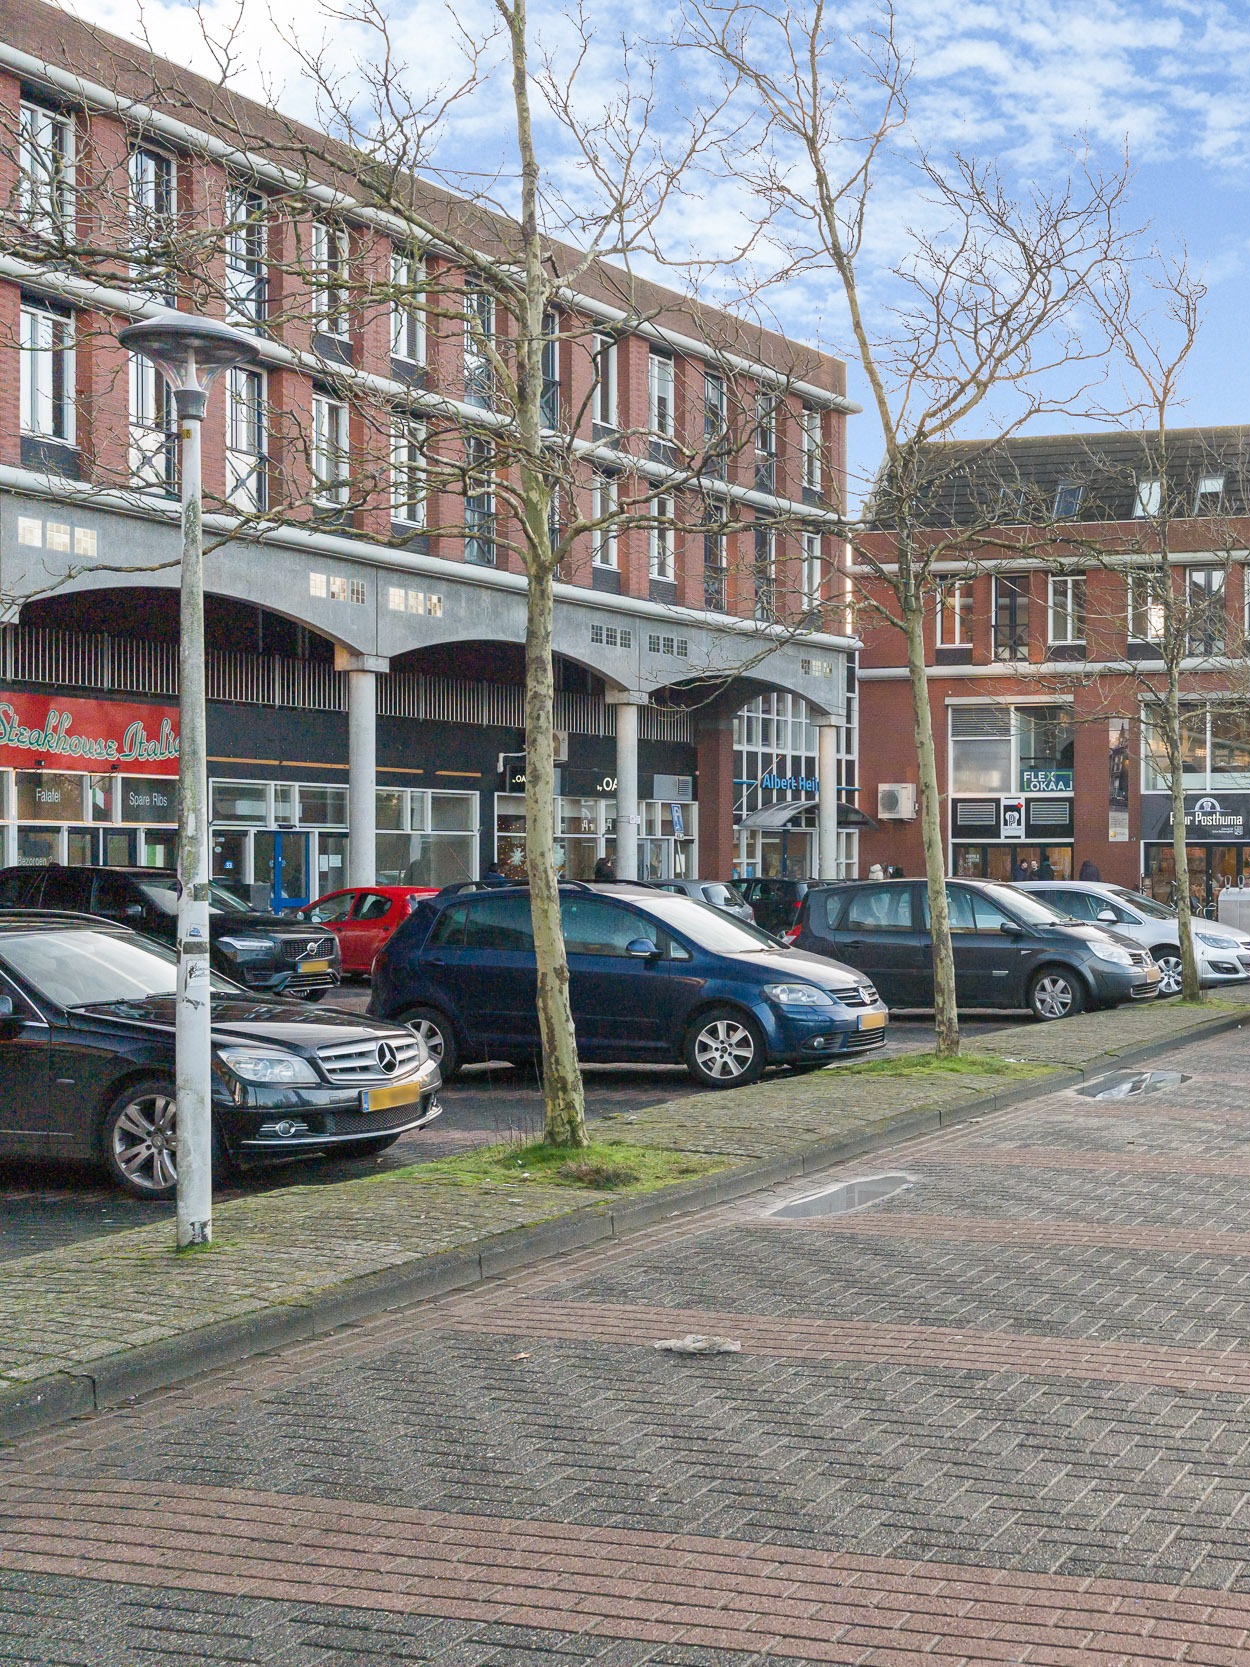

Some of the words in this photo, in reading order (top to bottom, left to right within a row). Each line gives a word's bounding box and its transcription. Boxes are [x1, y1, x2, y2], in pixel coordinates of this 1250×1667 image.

[0, 702, 119, 761] Steakhouse
[762, 774, 796, 789] Albert
[1023, 771, 1056, 782] FLEX
[36, 787, 61, 803] Falafel
[129, 791, 150, 808] Spare
[152, 792, 168, 806] Ribs
[1169, 811, 1193, 825] Pr
[1195, 811, 1243, 825] Posthuma
